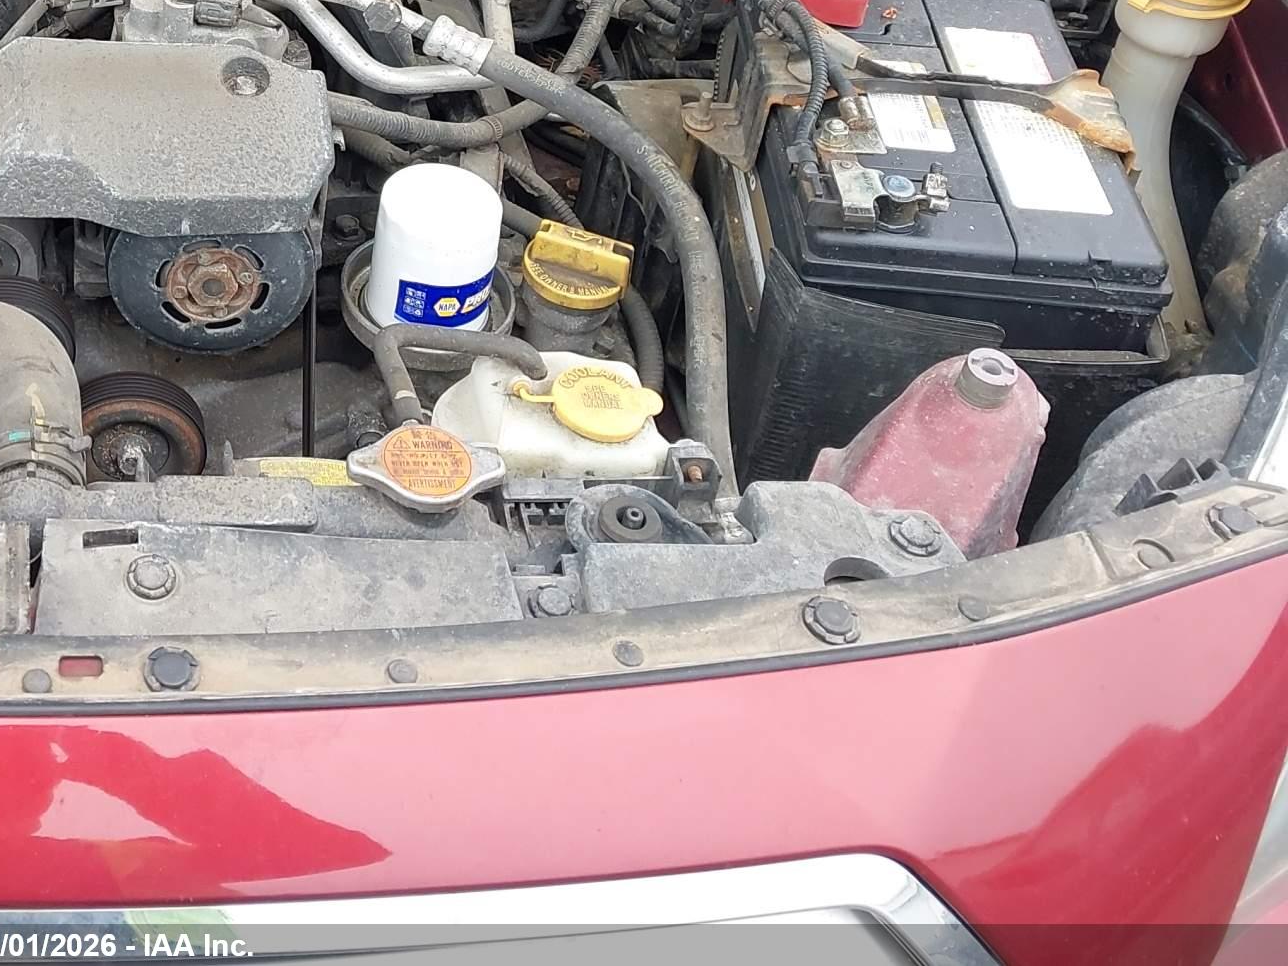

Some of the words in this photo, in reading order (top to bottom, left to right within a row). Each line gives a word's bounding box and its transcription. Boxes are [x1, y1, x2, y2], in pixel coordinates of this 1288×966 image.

[438, 302, 456, 311] NAPA
[559, 366, 633, 389] COOLANT
[412, 440, 453, 450] WARNING
